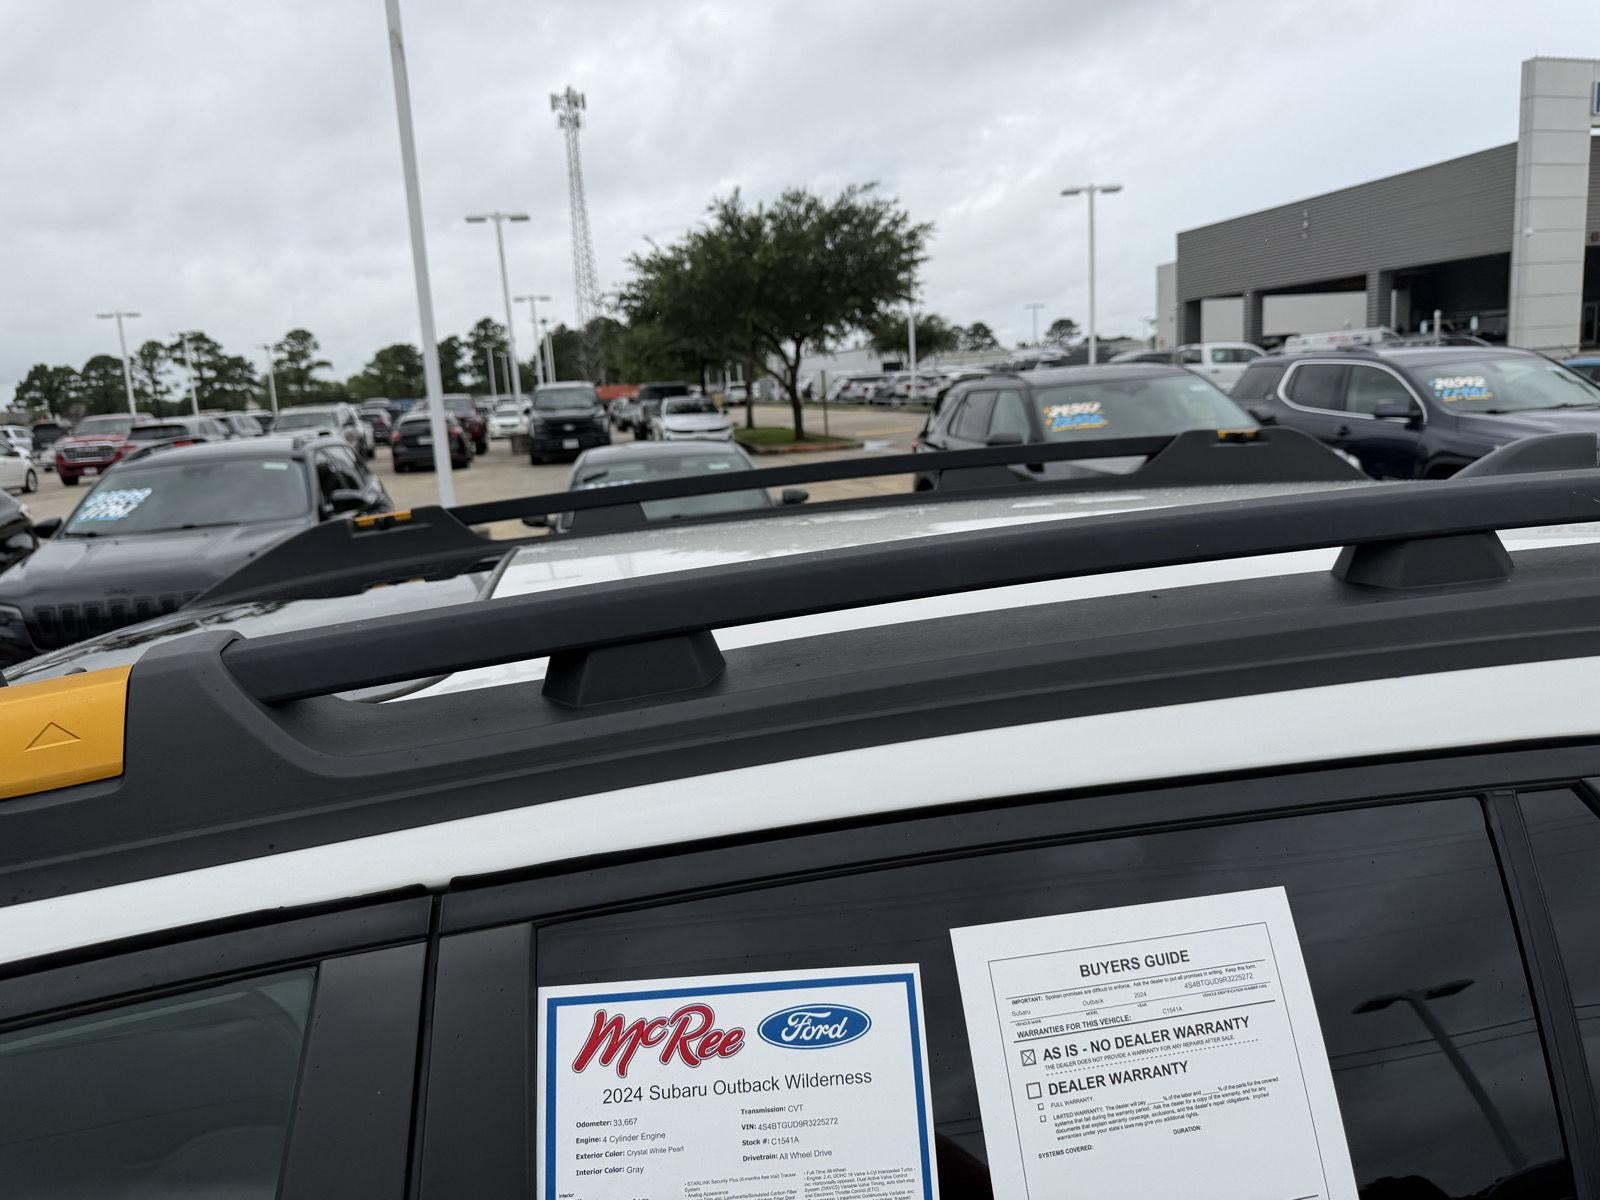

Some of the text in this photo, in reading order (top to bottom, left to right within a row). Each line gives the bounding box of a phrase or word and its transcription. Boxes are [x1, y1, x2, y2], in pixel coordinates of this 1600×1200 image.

[1079, 950, 1190, 977] BUYERS GUIDE
[1184, 972, 1253, 988] 4S4BTGUD9R3225272
[1012, 996, 1043, 1005] IMPORTANT:
[1082, 998, 1104, 1006] Outback
[1162, 1006, 1183, 1014] C1541A
[1017, 1014, 1131, 1038] WARRANTIES FOR THIS VEHICLE:
[572, 1003, 745, 1078] McRee
[1044, 1047, 1061, 1061] AS
[1065, 1044, 1078, 1057] IS
[1090, 1039, 1111, 1053] NO
[1114, 1029, 1171, 1049] DEALER
[1173, 1016, 1249, 1039] WARRANTY
[1056, 1060, 1077, 1069] DEALER
[1104, 1052, 1126, 1060] PROVIDE
[1131, 1047, 1159, 1056] WARRANTY
[1183, 1039, 1204, 1047] REPAIRS
[1048, 1060, 1187, 1096] DEALER WARRANTY
[603, 1072, 872, 1104] 2024 Subaru Outback Wilderness
[1053, 1112, 1074, 1120] LIMITED
[1181, 1092, 1192, 1100] labor
[1236, 1083, 1246, 1092] parts
[1064, 1096, 1092, 1106] WARRANTY
[741, 1104, 803, 1115] Transmission: CVT
[1056, 1126, 1081, 1134] documents
[1091, 1119, 1108, 1128] explain
[1108, 1117, 1127, 1125] warranty
[1151, 1109, 1176, 1117] exclusions,
[1186, 1106, 1194, 1114] the
[1194, 1102, 1212, 1110] dealer's
[1226, 1096, 1250, 1104] obligations.
[576, 1118, 637, 1128] Odometer: 33,667
[758, 1117, 838, 1131] 4S4BTGUD9R3225272
[1057, 1133, 1082, 1141] warranties
[1097, 1127, 1107, 1135] your
[1164, 1113, 1185, 1122] additional
[1173, 1125, 1202, 1135] DURATION:
[609, 1134, 639, 1144] Cylinder
[640, 1132, 666, 1141] Engine
[771, 1136, 800, 1145] C1541A
[576, 1152, 603, 1160] Exterior
[626, 1148, 648, 1157] Crystal
[743, 1153, 778, 1162] Drivetrain:
[790, 1151, 812, 1159] Wheel
[814, 1149, 832, 1157] Drive
[1038, 1144, 1093, 1159] SYSTEMS COVERED:
[576, 1168, 602, 1176] Interior
[626, 1166, 644, 1174] Gray
